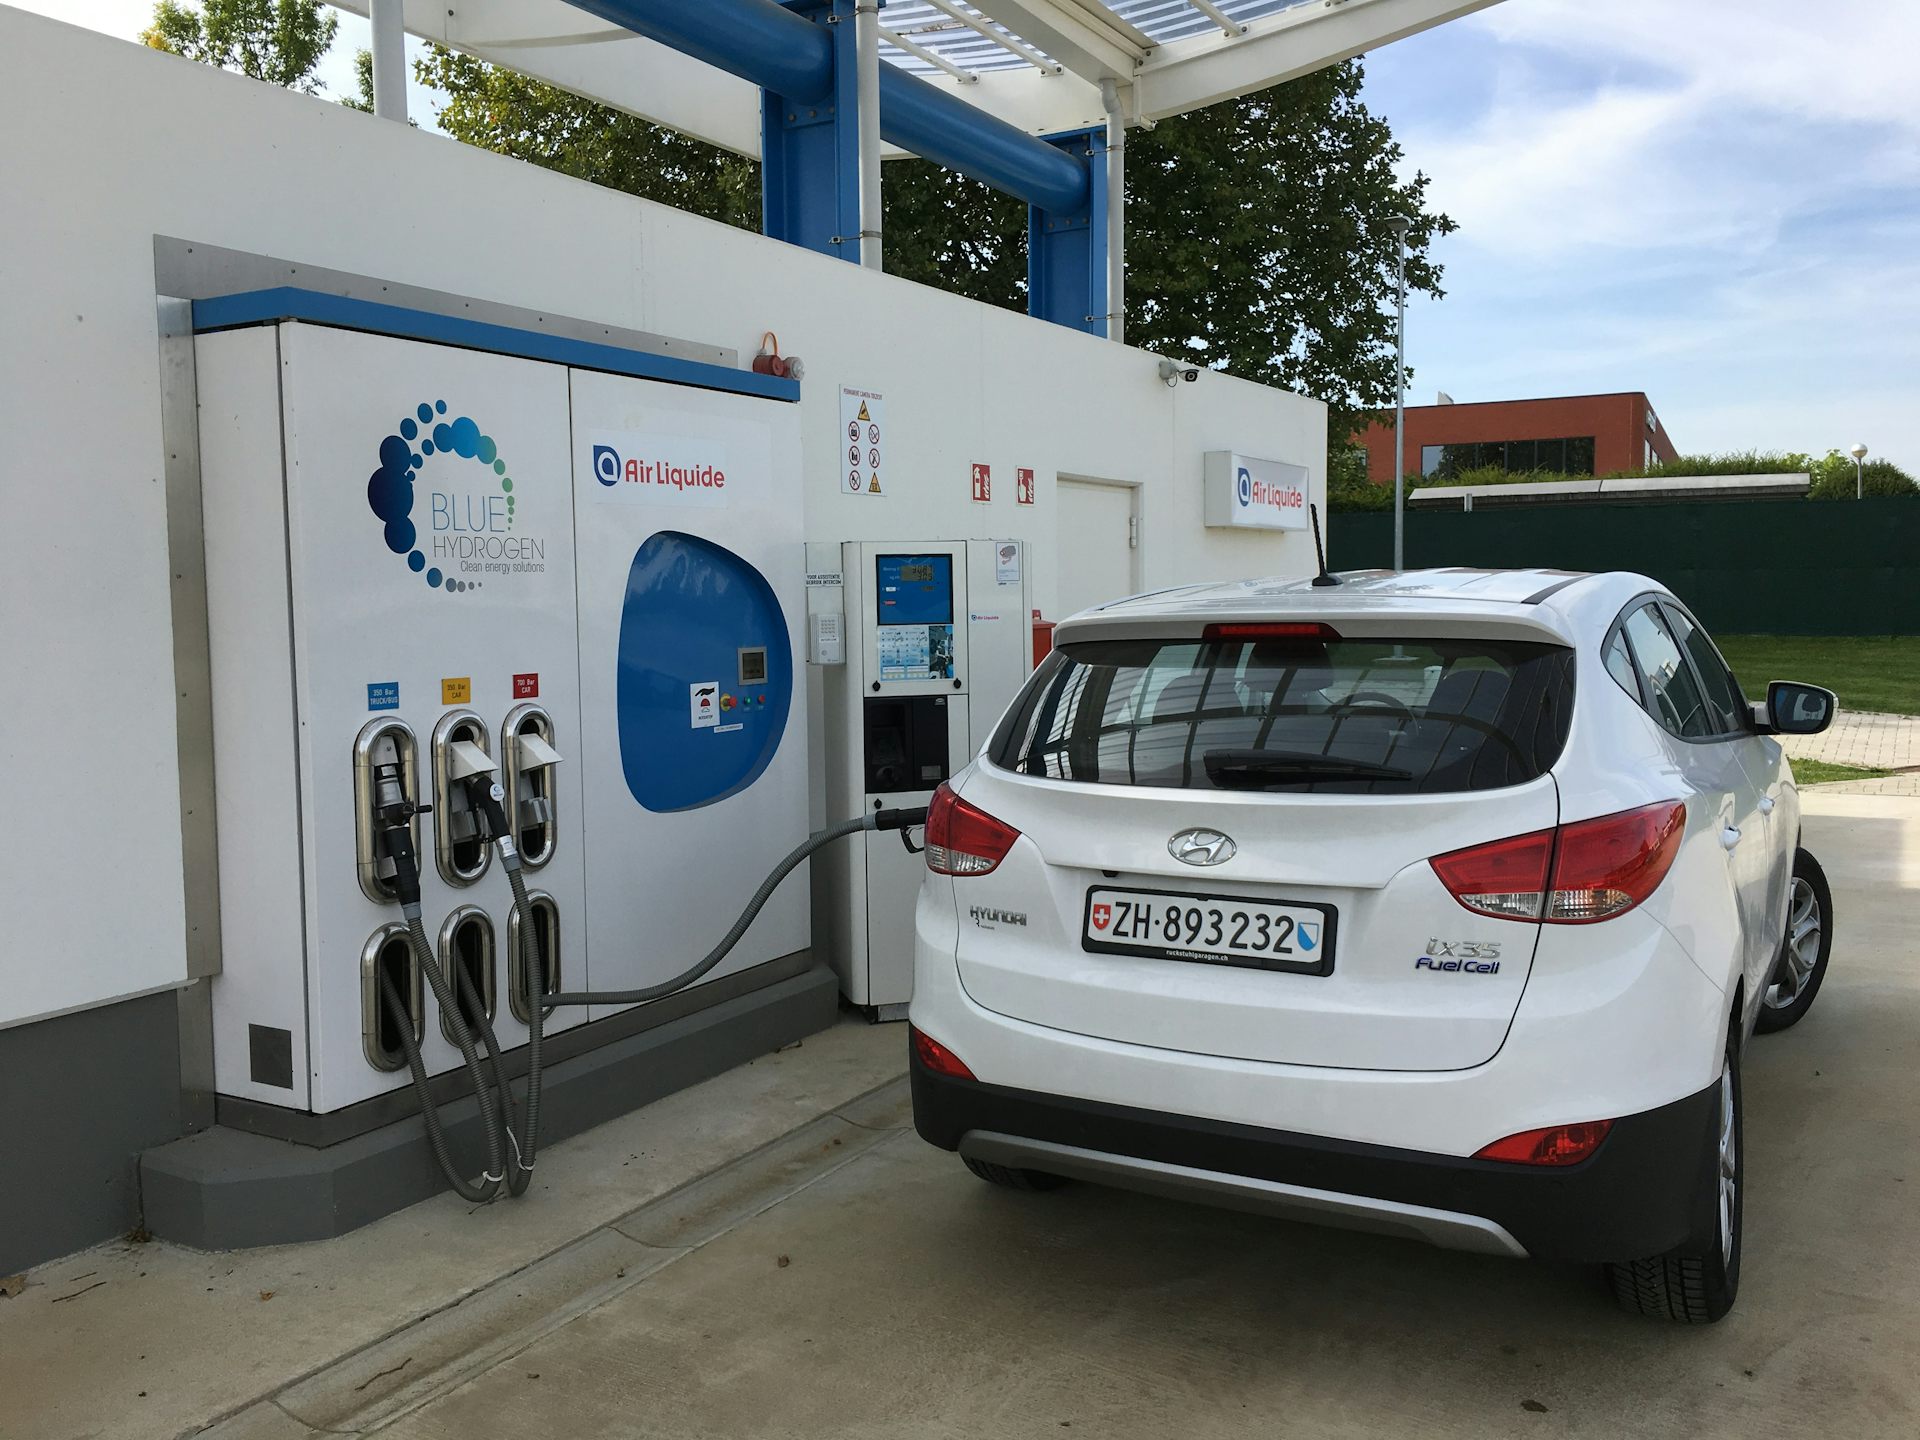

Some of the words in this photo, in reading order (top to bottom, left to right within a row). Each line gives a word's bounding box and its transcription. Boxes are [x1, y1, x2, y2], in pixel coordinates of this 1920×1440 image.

[625, 459, 653, 483] Air
[656, 461, 725, 491] Liquide
[1252, 481, 1266, 504] Air
[1268, 483, 1302, 511] Liquide
[432, 492, 505, 532] BLUE
[433, 535, 545, 560] HYDROGEN
[460, 560, 482, 572] Clean
[485, 562, 511, 574] energy
[512, 561, 545, 573] solutions
[384, 688, 394, 696] Bar
[526, 678, 535, 686] Bar
[970, 905, 1027, 926] HYUNDAI
[1166, 949, 1229, 961] ruckstuhlgaragen.ch
[1425, 936, 1501, 959] ix35
[1415, 957, 1463, 972] Fuel
[1464, 961, 1500, 974] Cell
